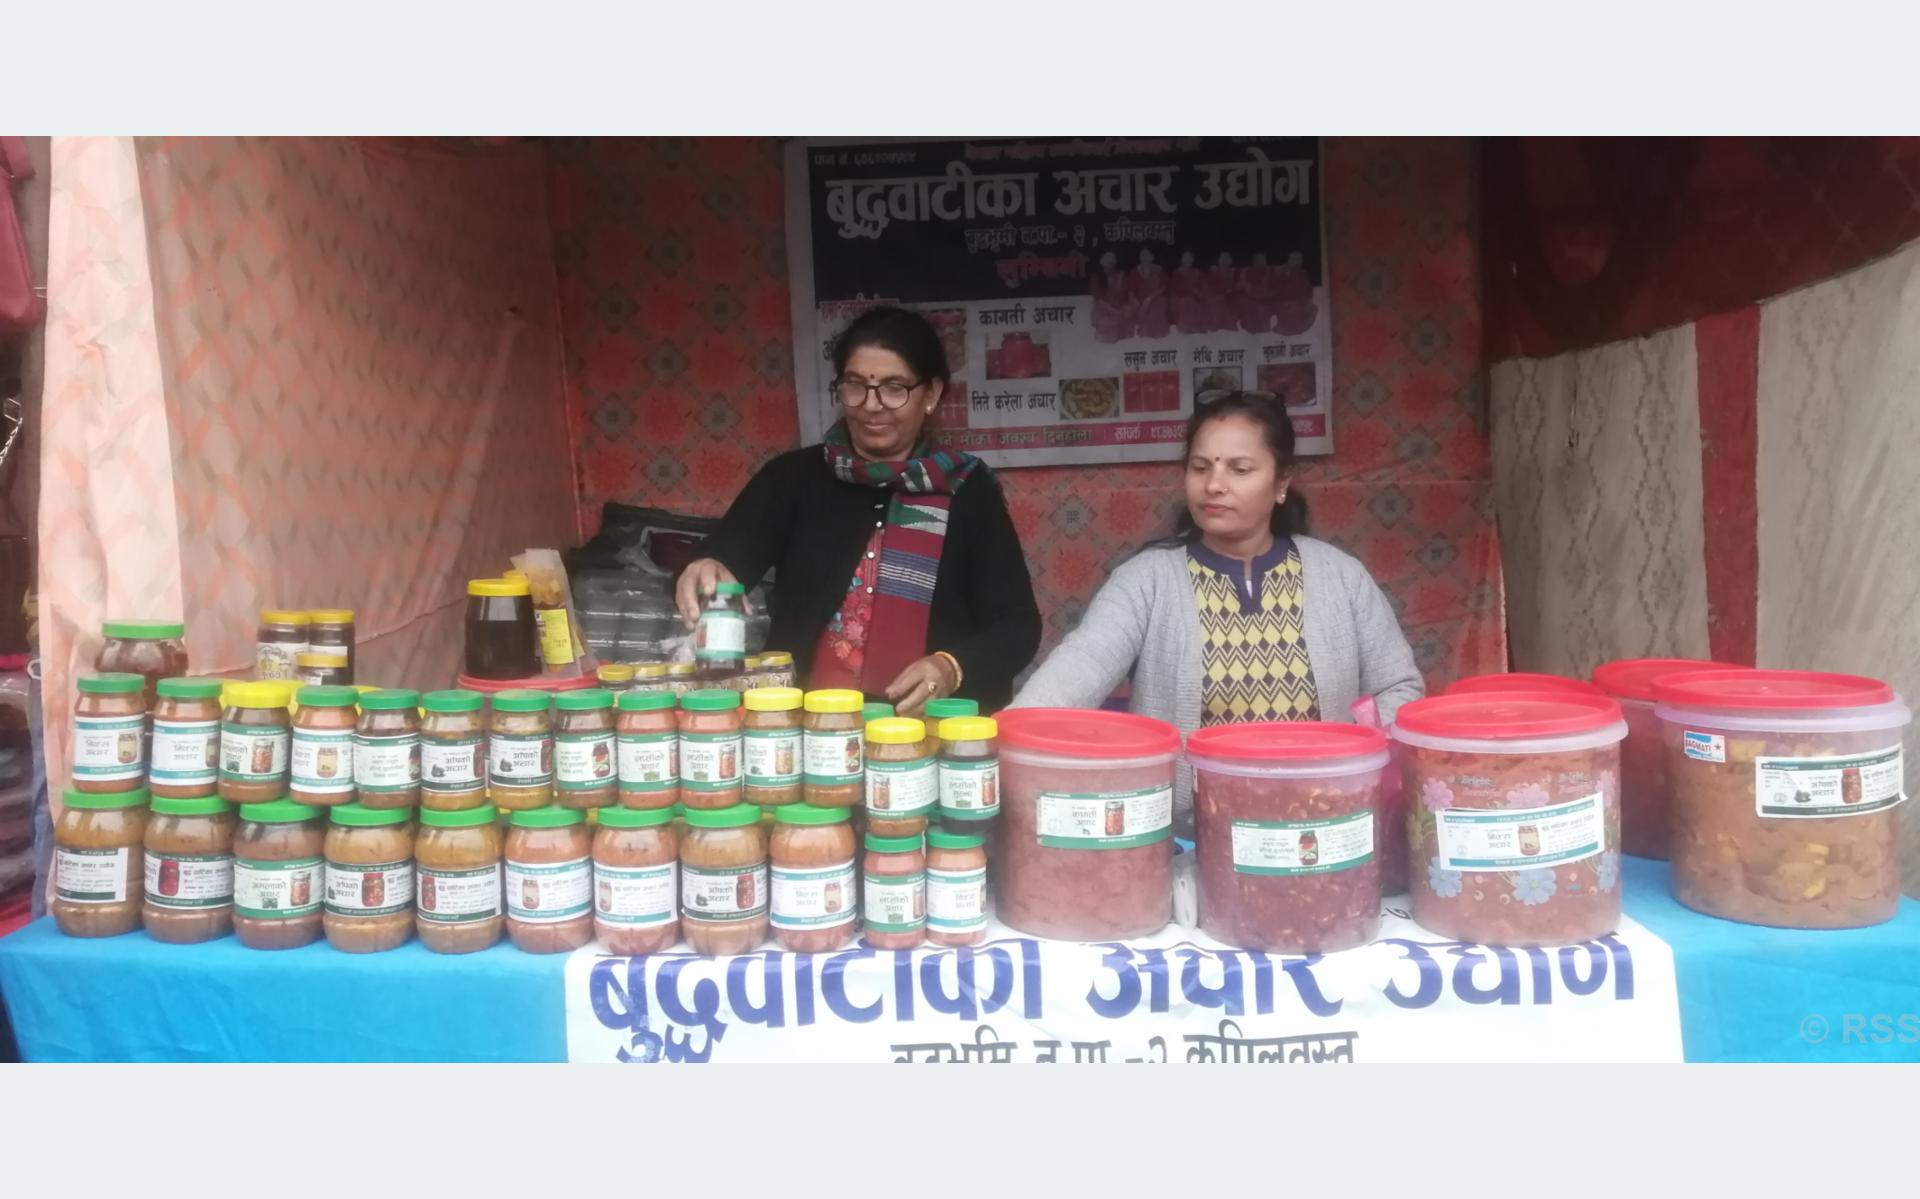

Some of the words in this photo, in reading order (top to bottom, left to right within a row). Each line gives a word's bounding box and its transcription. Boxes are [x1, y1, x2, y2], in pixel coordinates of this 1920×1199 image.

[1052, 165, 1181, 215] अचार
[1193, 146, 1314, 210] उद्योग
[979, 303, 1026, 327] कागती
[1033, 305, 1076, 326] अचार
[1151, 350, 1178, 367] अचार
[1218, 349, 1246, 364] अचार
[995, 393, 1024, 416] करेला
[1028, 391, 1057, 412] अचार
[1083, 941, 1344, 1018] अचार
